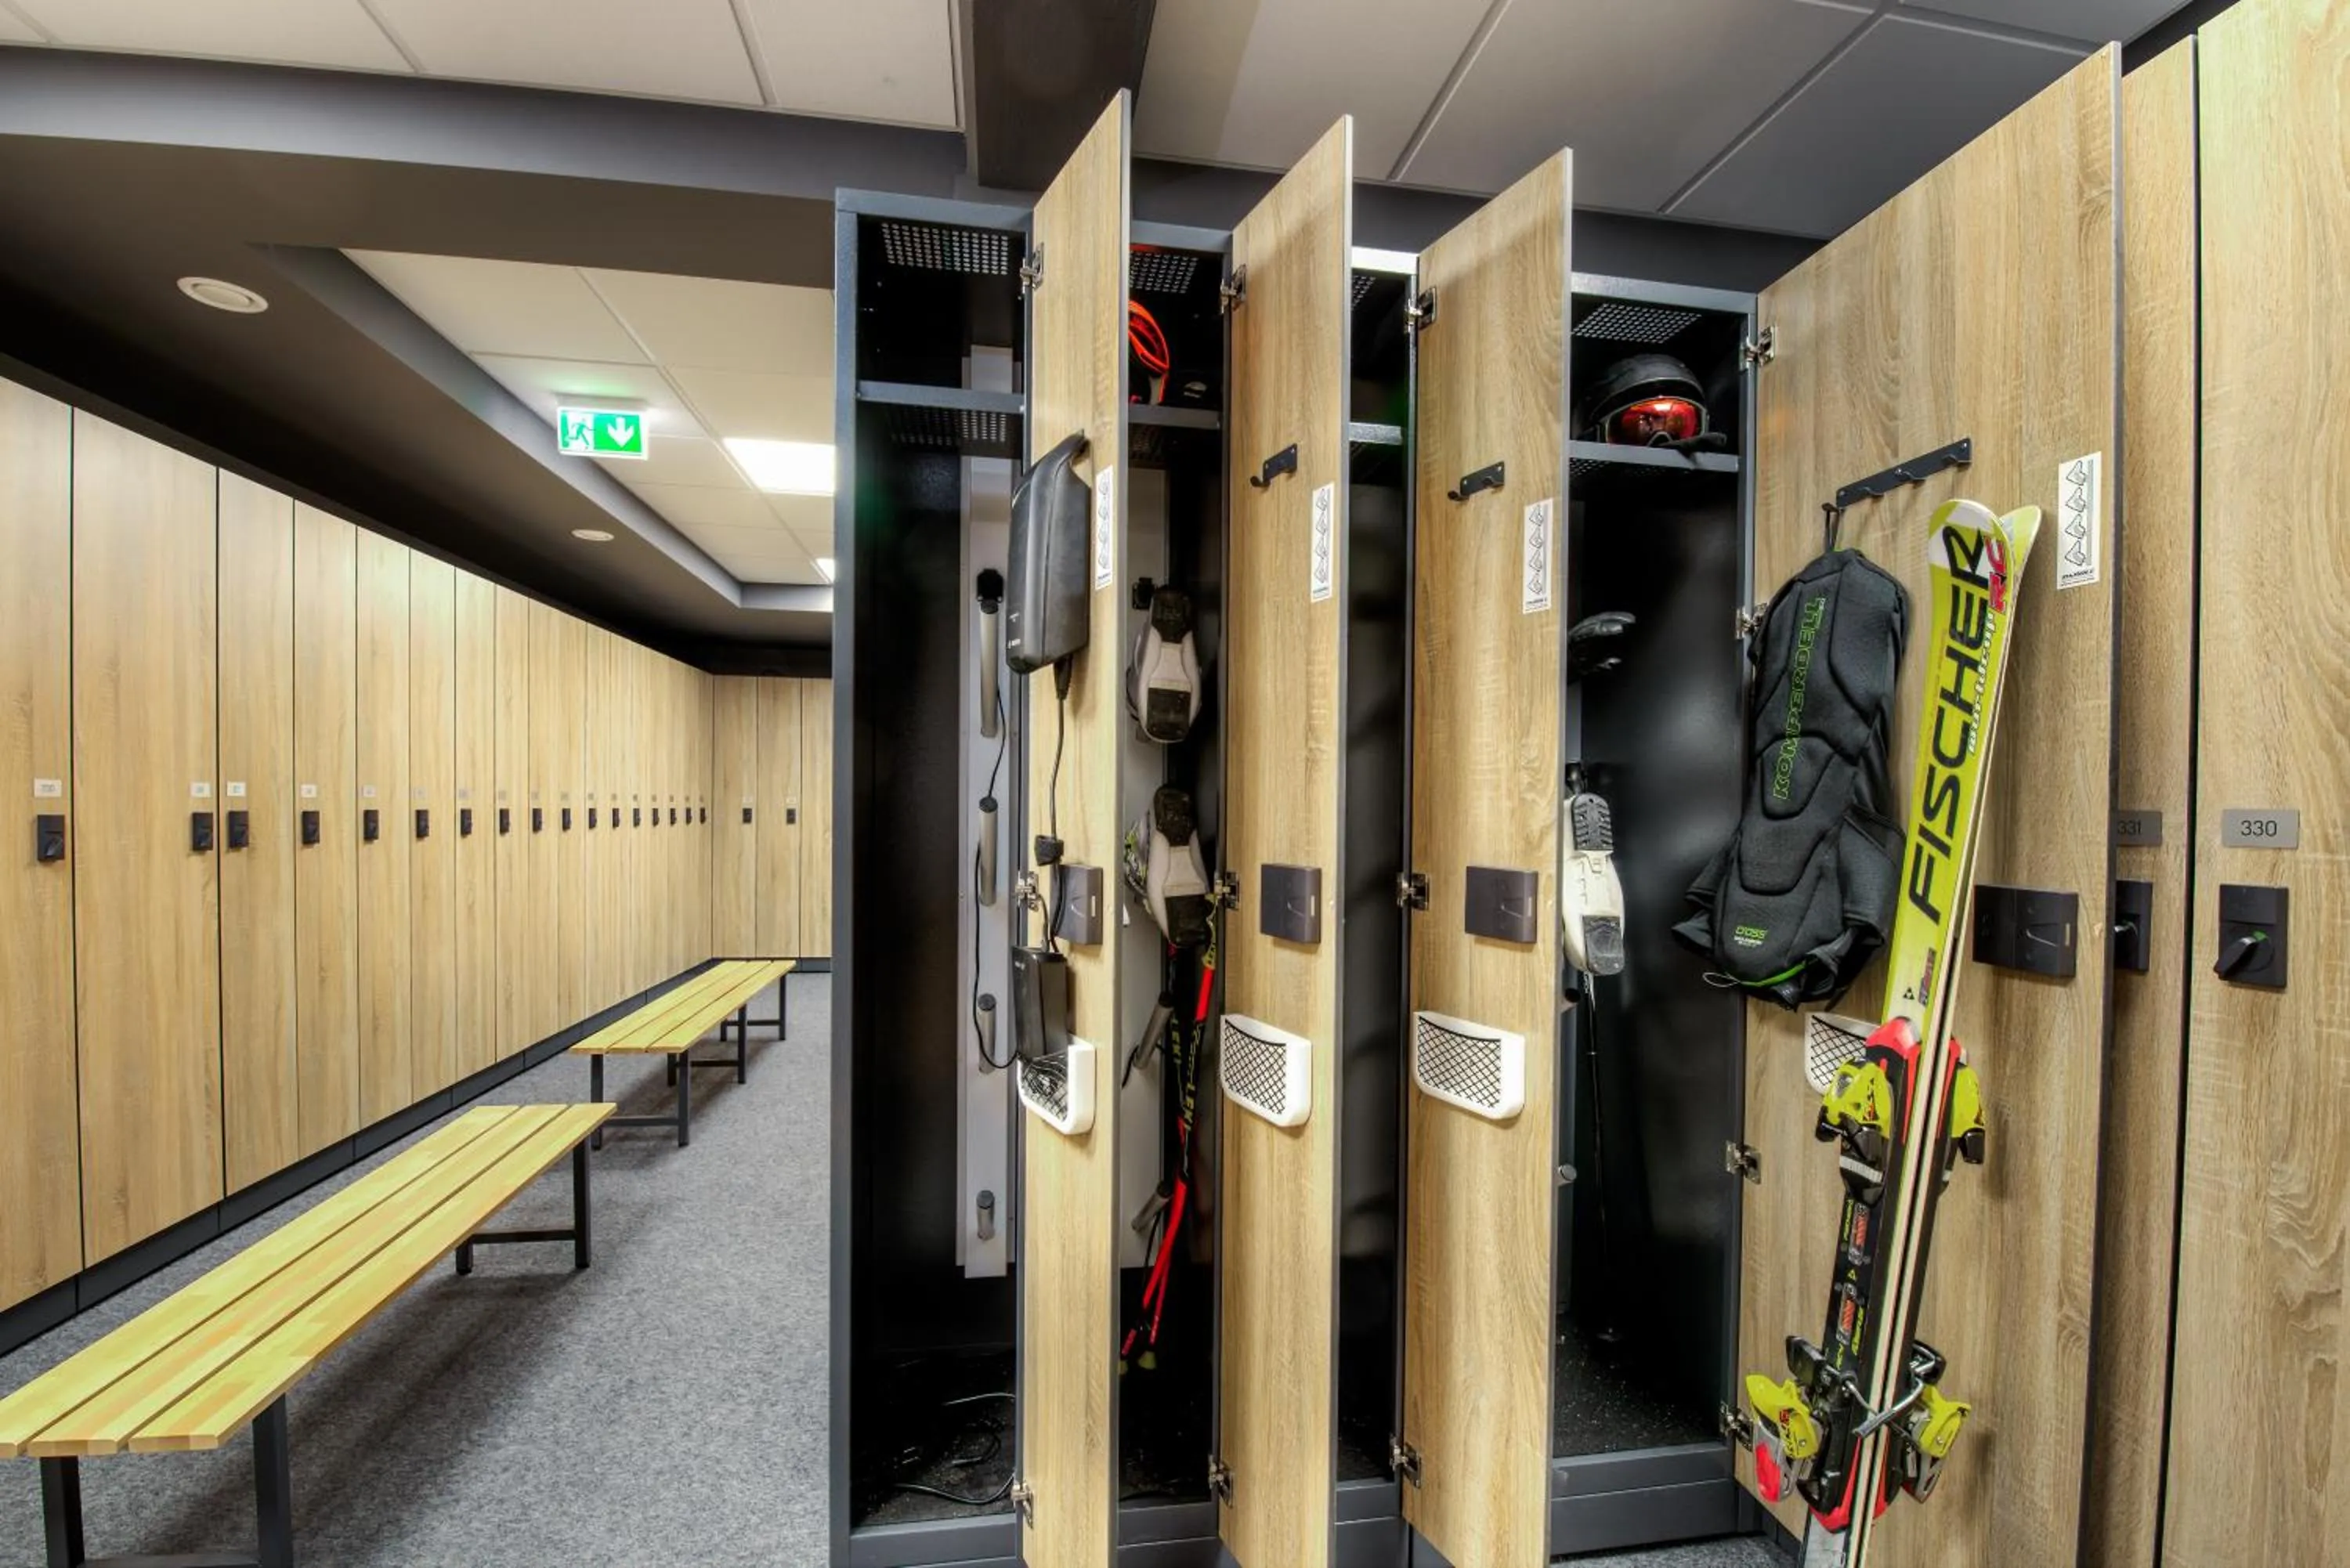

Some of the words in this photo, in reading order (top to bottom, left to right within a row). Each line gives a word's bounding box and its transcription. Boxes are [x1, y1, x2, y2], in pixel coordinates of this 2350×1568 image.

[1773, 598, 1826, 800] KOMPERDELL
[1909, 526, 1989, 925] FISCHER
[2117, 821, 2142, 836] 331
[2241, 820, 2277, 837] 330
